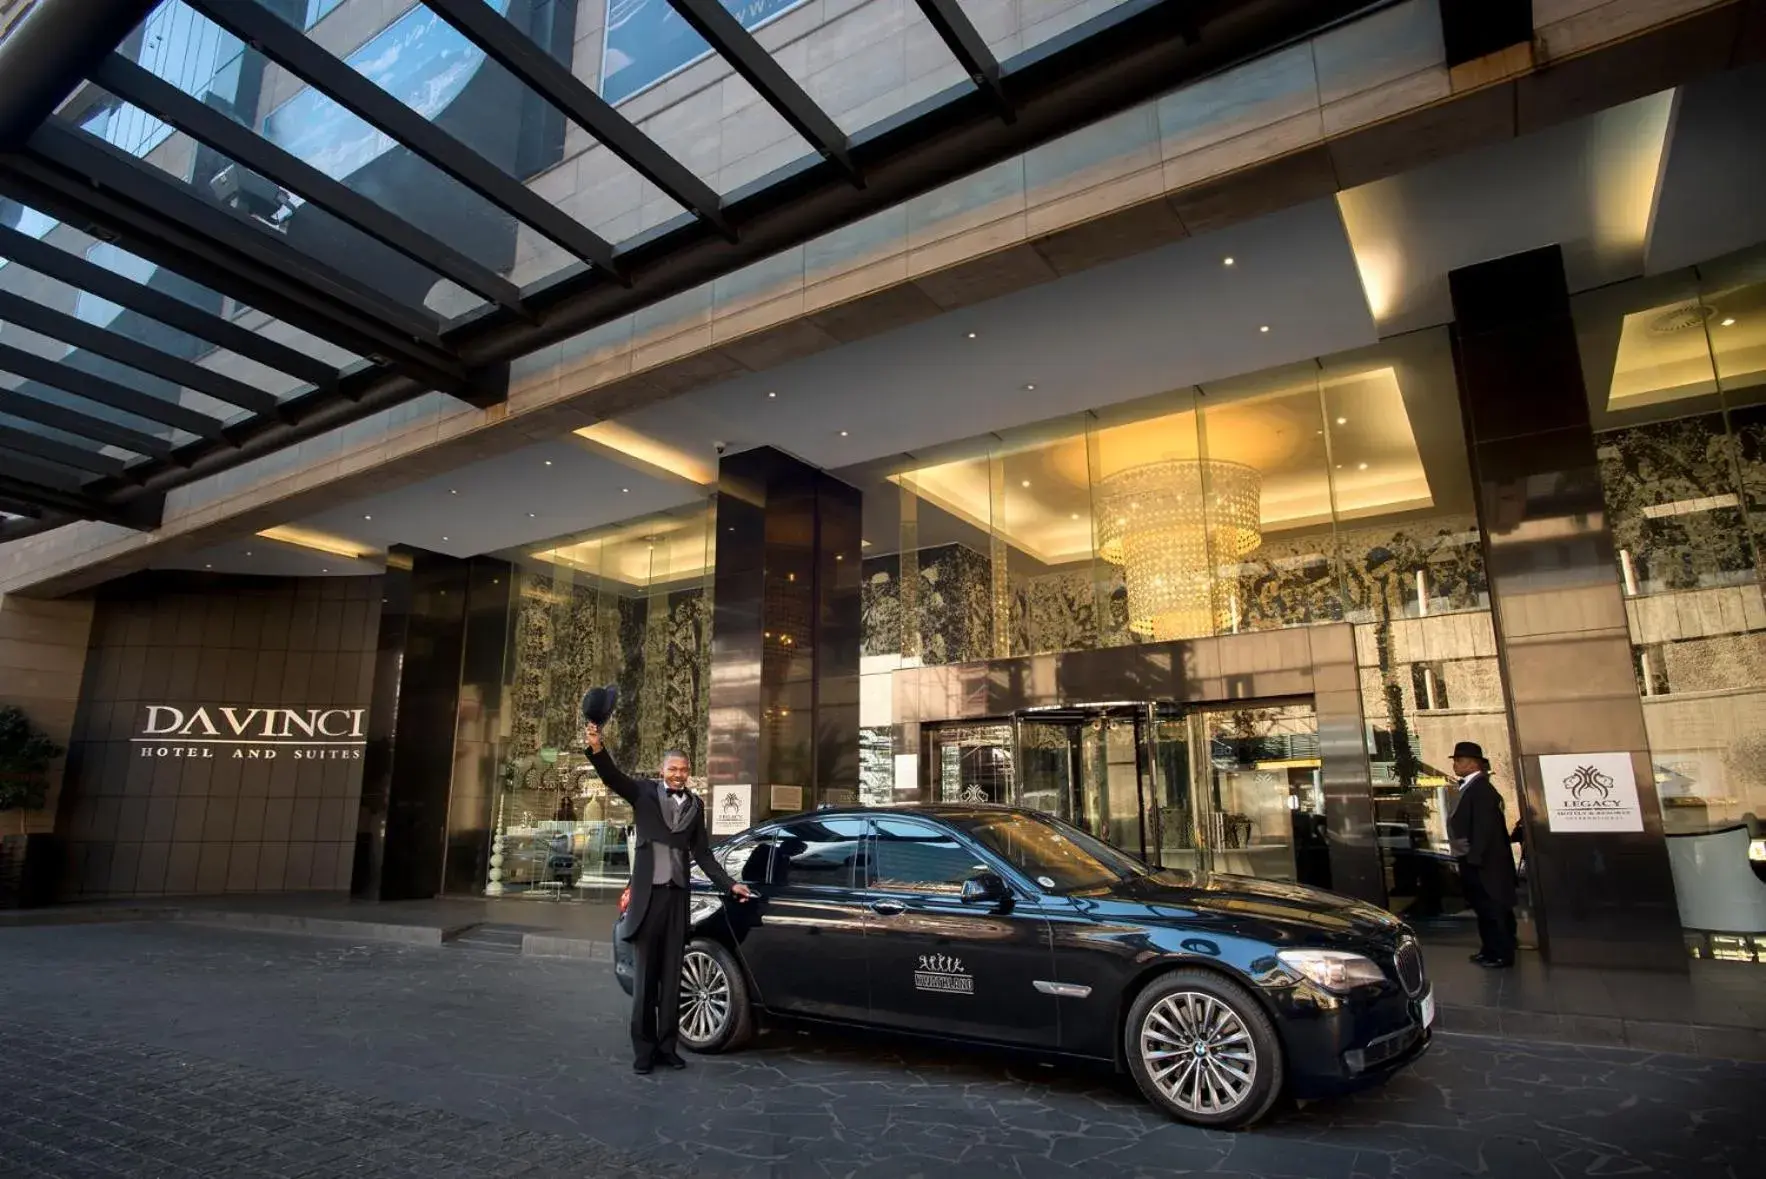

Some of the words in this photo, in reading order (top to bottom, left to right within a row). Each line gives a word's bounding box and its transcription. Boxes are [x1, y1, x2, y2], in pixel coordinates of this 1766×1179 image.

[140, 747, 213, 758] HOTEL
[232, 748, 277, 760] AND
[294, 749, 361, 760] SUITES
[1563, 800, 1621, 808] LEGACY
